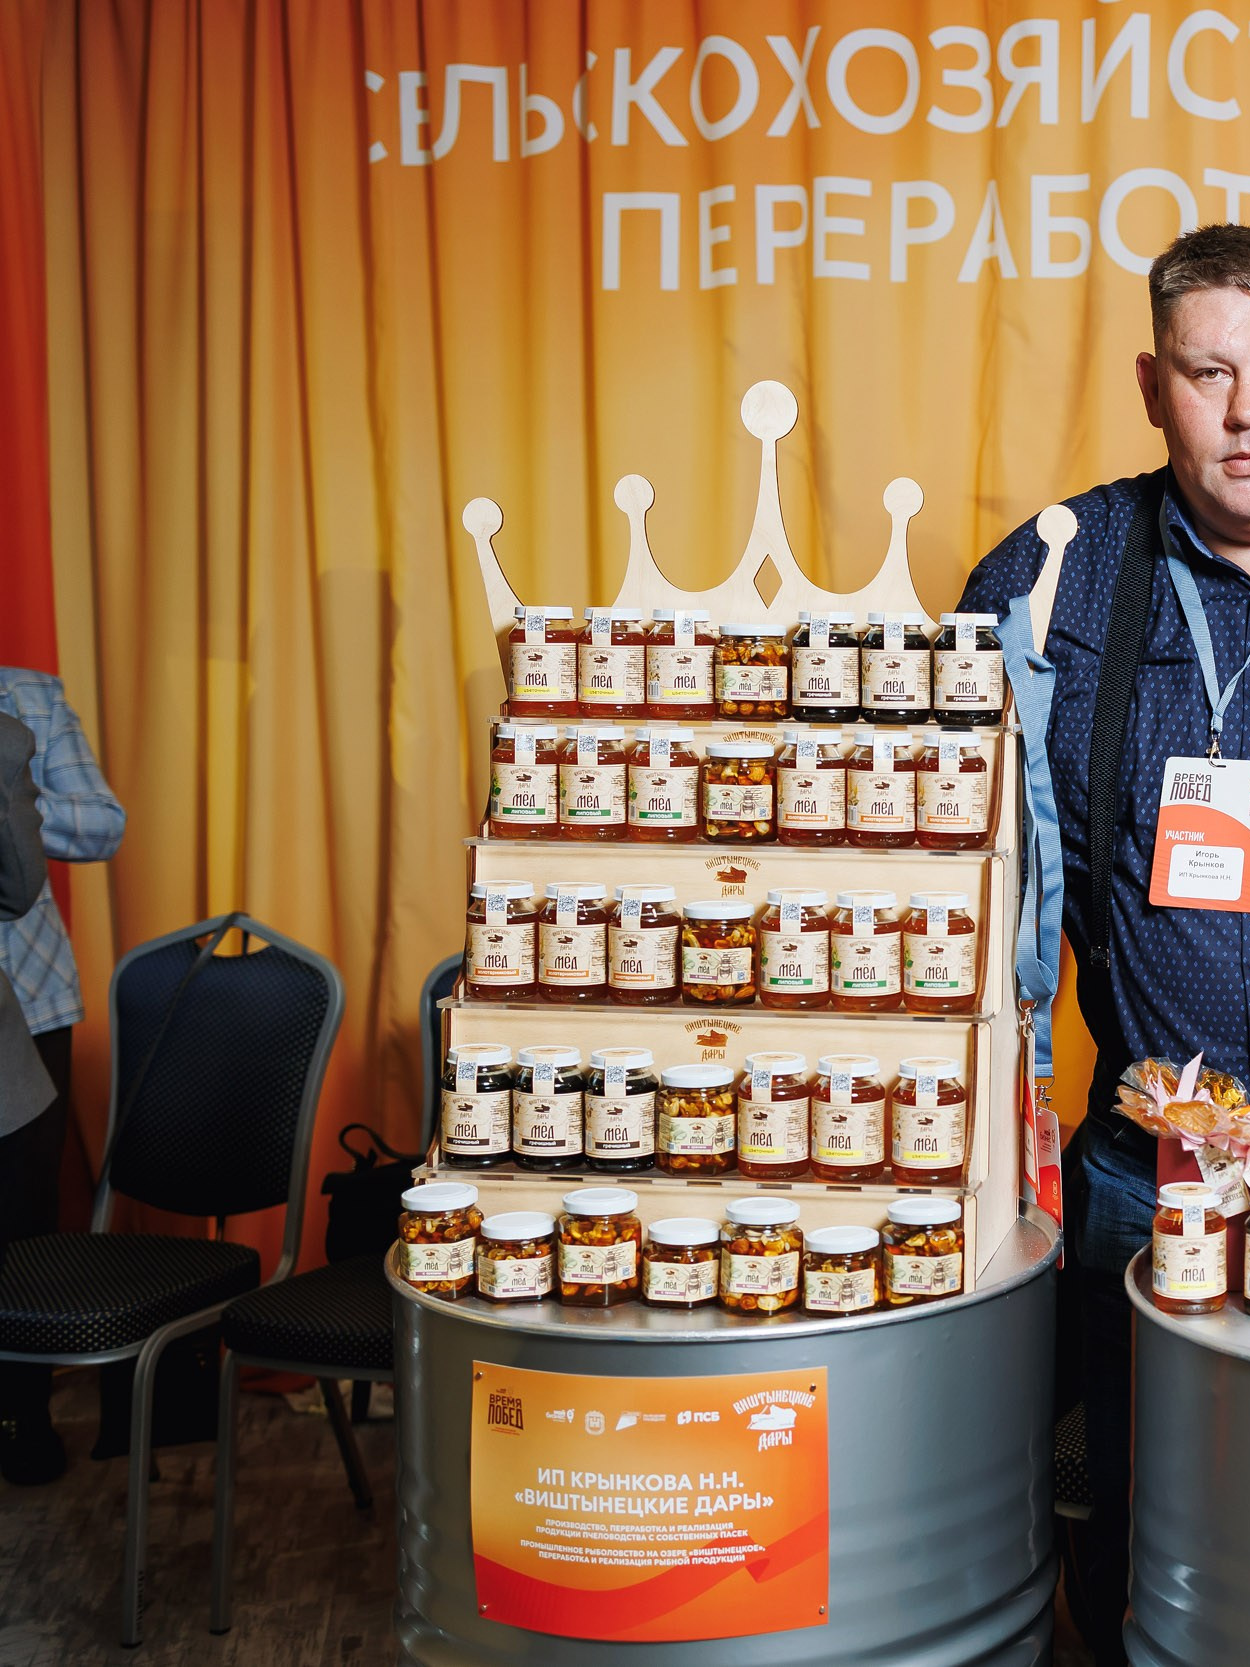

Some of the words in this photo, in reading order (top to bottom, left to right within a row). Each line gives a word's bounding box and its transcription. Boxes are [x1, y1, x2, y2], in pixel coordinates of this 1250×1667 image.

[1174, 773, 1212, 783] ВРЕМЯ
[1170, 783, 1212, 802] ПОБЕД
[1165, 829, 1204, 842] УЧАСТНИК
[1195, 850, 1220, 859] Игорь
[704, 856, 761, 871] ВИШТЫНЕЦКИЕ
[1188, 860, 1225, 868] Крынков
[721, 885, 745, 898] ДАРЫ
[685, 1019, 743, 1035] ВИШТЫНЕЦКИЕ
[701, 1048, 725, 1062] ДАРЫ
[489, 1393, 522, 1408] ВРЕМЯ
[733, 1389, 816, 1415] ВИШТЫНЕЦКИЕ
[488, 1404, 524, 1430] ПОБЕД
[694, 1411, 720, 1422] ПСБ
[758, 1430, 792, 1452] ДАРЫ
[537, 1468, 564, 1486] ИП
[571, 1471, 693, 1492] КРЫНКОВА
[699, 1471, 744, 1490] Н.Н.
[515, 1488, 688, 1518] «ВИШТЫНЕЦКИЕ
[694, 1492, 774, 1516] ДАРЫ»
[536, 1526, 581, 1538] ПРОДУКЦИИ
[583, 1532, 646, 1542] ПЧЕЛОВОДСТВА
[656, 1532, 718, 1541] СОБСТВЕННЫХ
[720, 1529, 748, 1539] ПАСЕК
[610, 1524, 667, 1533] ПЕРЕРАБОТКА
[677, 1522, 733, 1532] РЕАЛИЗАЦИЯ
[520, 1539, 584, 1554] ПРОМЫШЛЕННОЕ
[585, 1548, 645, 1557] РЫБОЛОВСТВО
[660, 1549, 688, 1557] ОЗЕРЕ
[538, 1550, 589, 1564] ПЕРЕРАБОТКА
[598, 1557, 652, 1567] РЕАЛИЗАЦИЯ
[654, 1556, 690, 1565] РЫБНОЙ
[692, 1554, 745, 1565] ПРОДУКЦИИ
